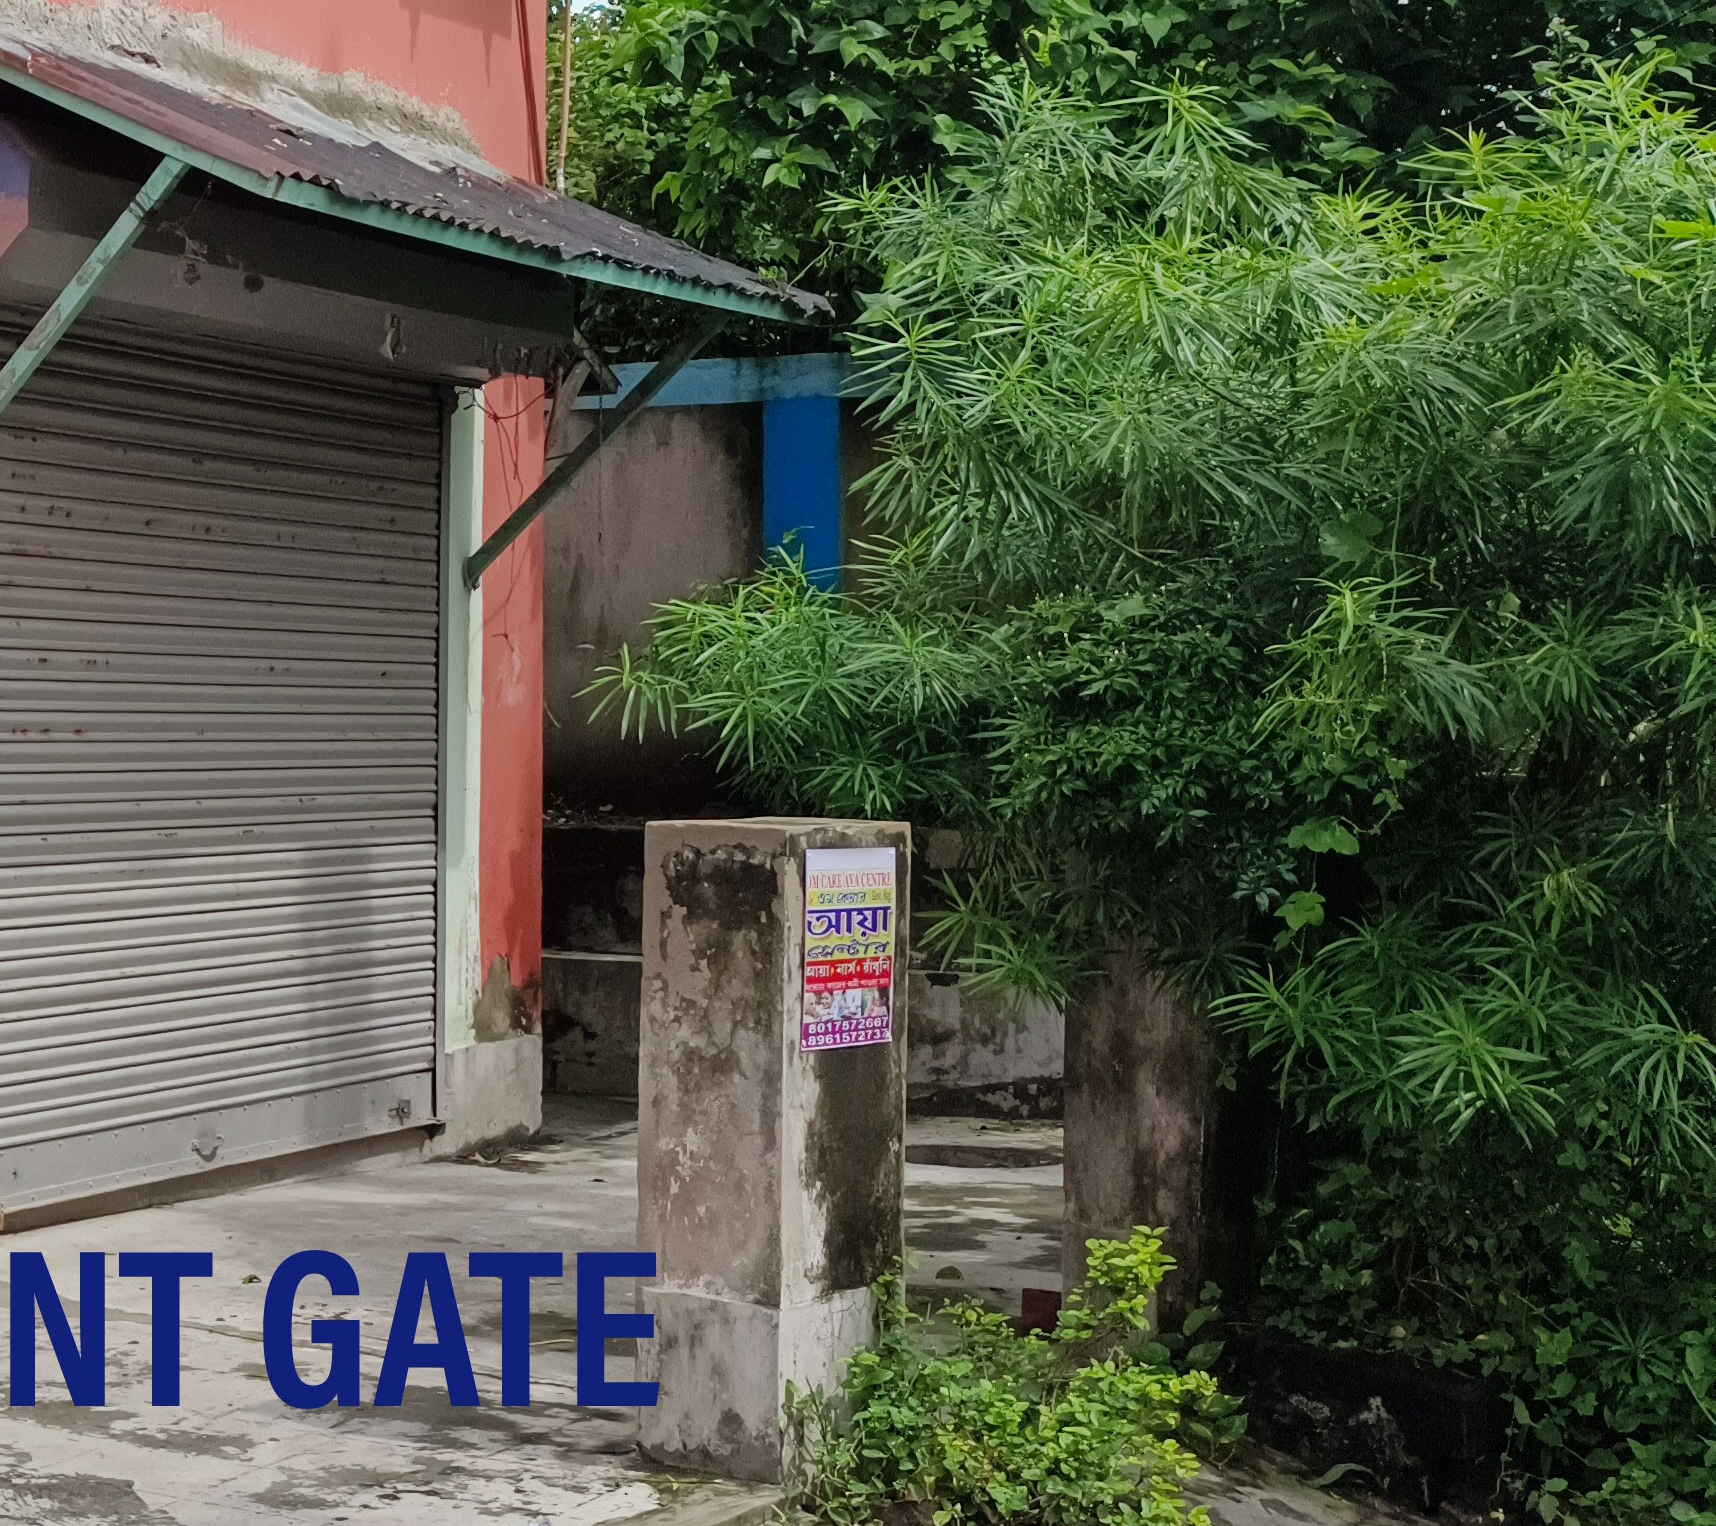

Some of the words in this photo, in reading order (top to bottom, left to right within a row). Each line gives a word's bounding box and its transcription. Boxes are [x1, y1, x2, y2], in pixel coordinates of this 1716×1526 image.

[821, 873, 841, 888] CARE
[861, 871, 891, 887] CENTRE
[807, 905, 892, 937] আয়া
